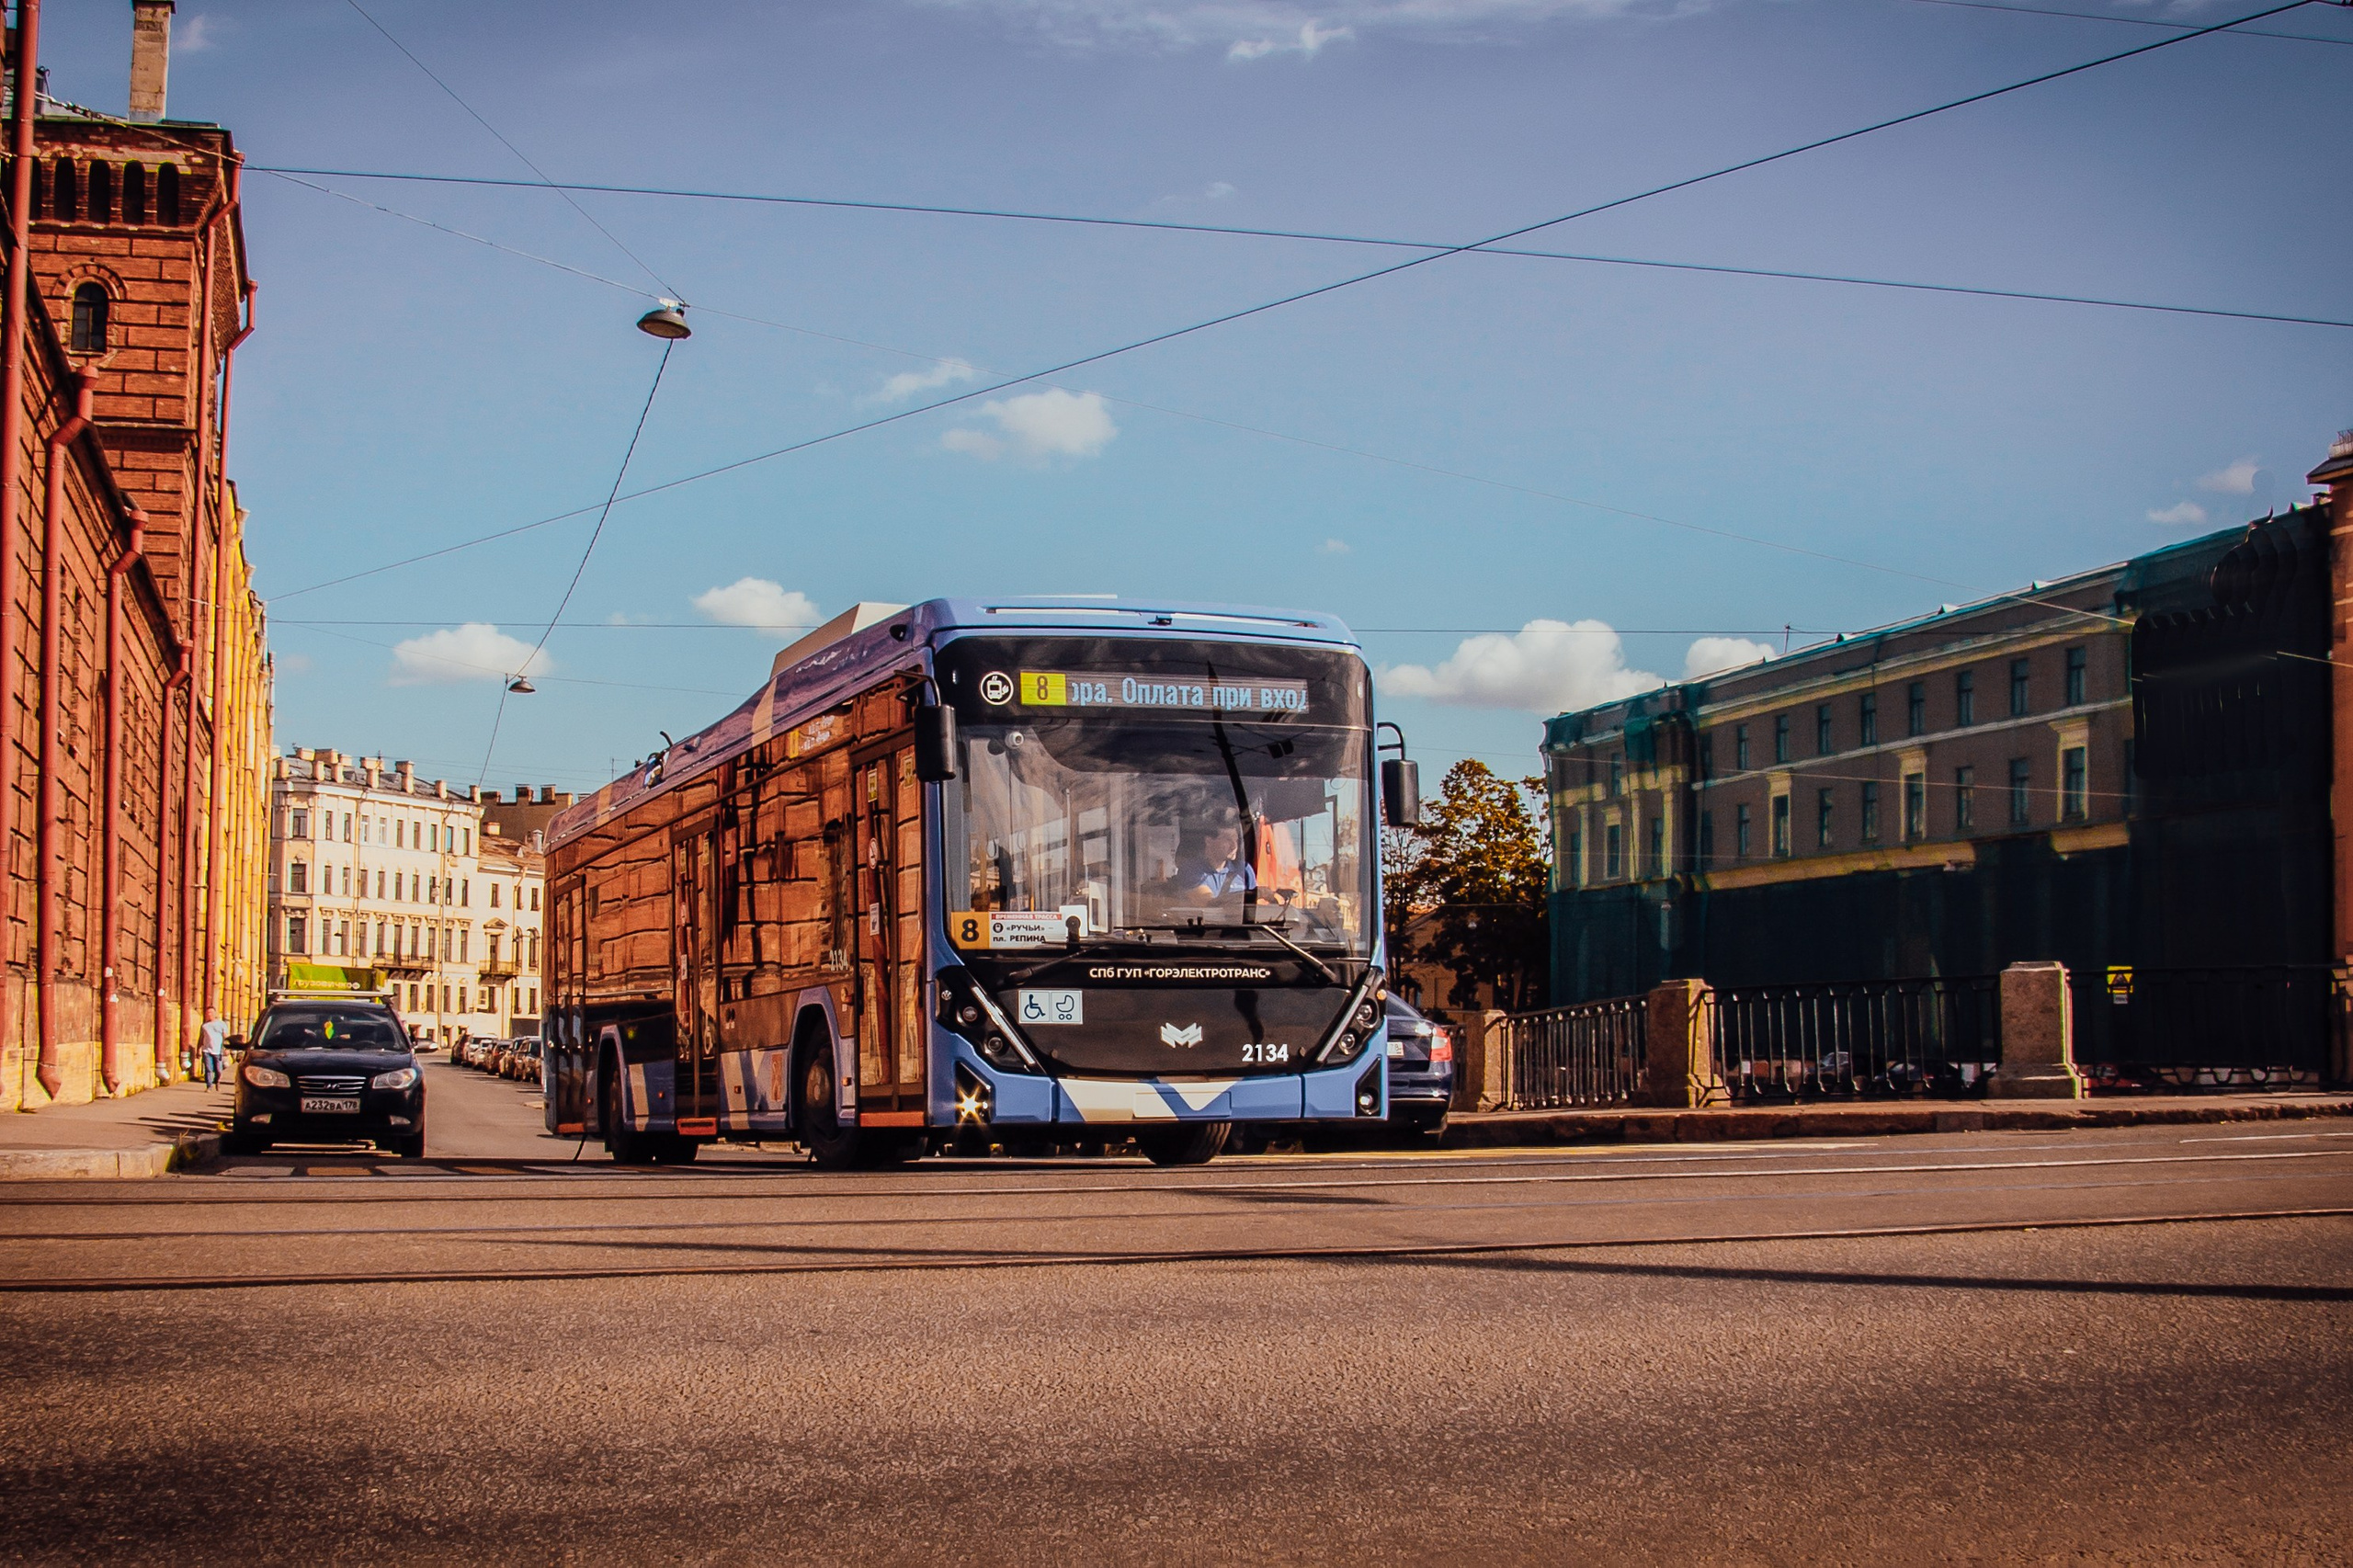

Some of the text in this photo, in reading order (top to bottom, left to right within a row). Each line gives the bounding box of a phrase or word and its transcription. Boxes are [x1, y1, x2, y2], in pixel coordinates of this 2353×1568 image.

[1036, 675, 1049, 700] 8
[1121, 677, 1204, 707] Оплата
[1212, 685, 1252, 710] при
[961, 918, 980, 942] 8
[1009, 935, 1046, 943] РЕПИНА
[829, 949, 848, 971] 2134
[1089, 967, 1271, 978] СПб ГУП «ГОРЭЛЕКТРОТРАНС»
[1242, 1043, 1289, 1062] 2134
